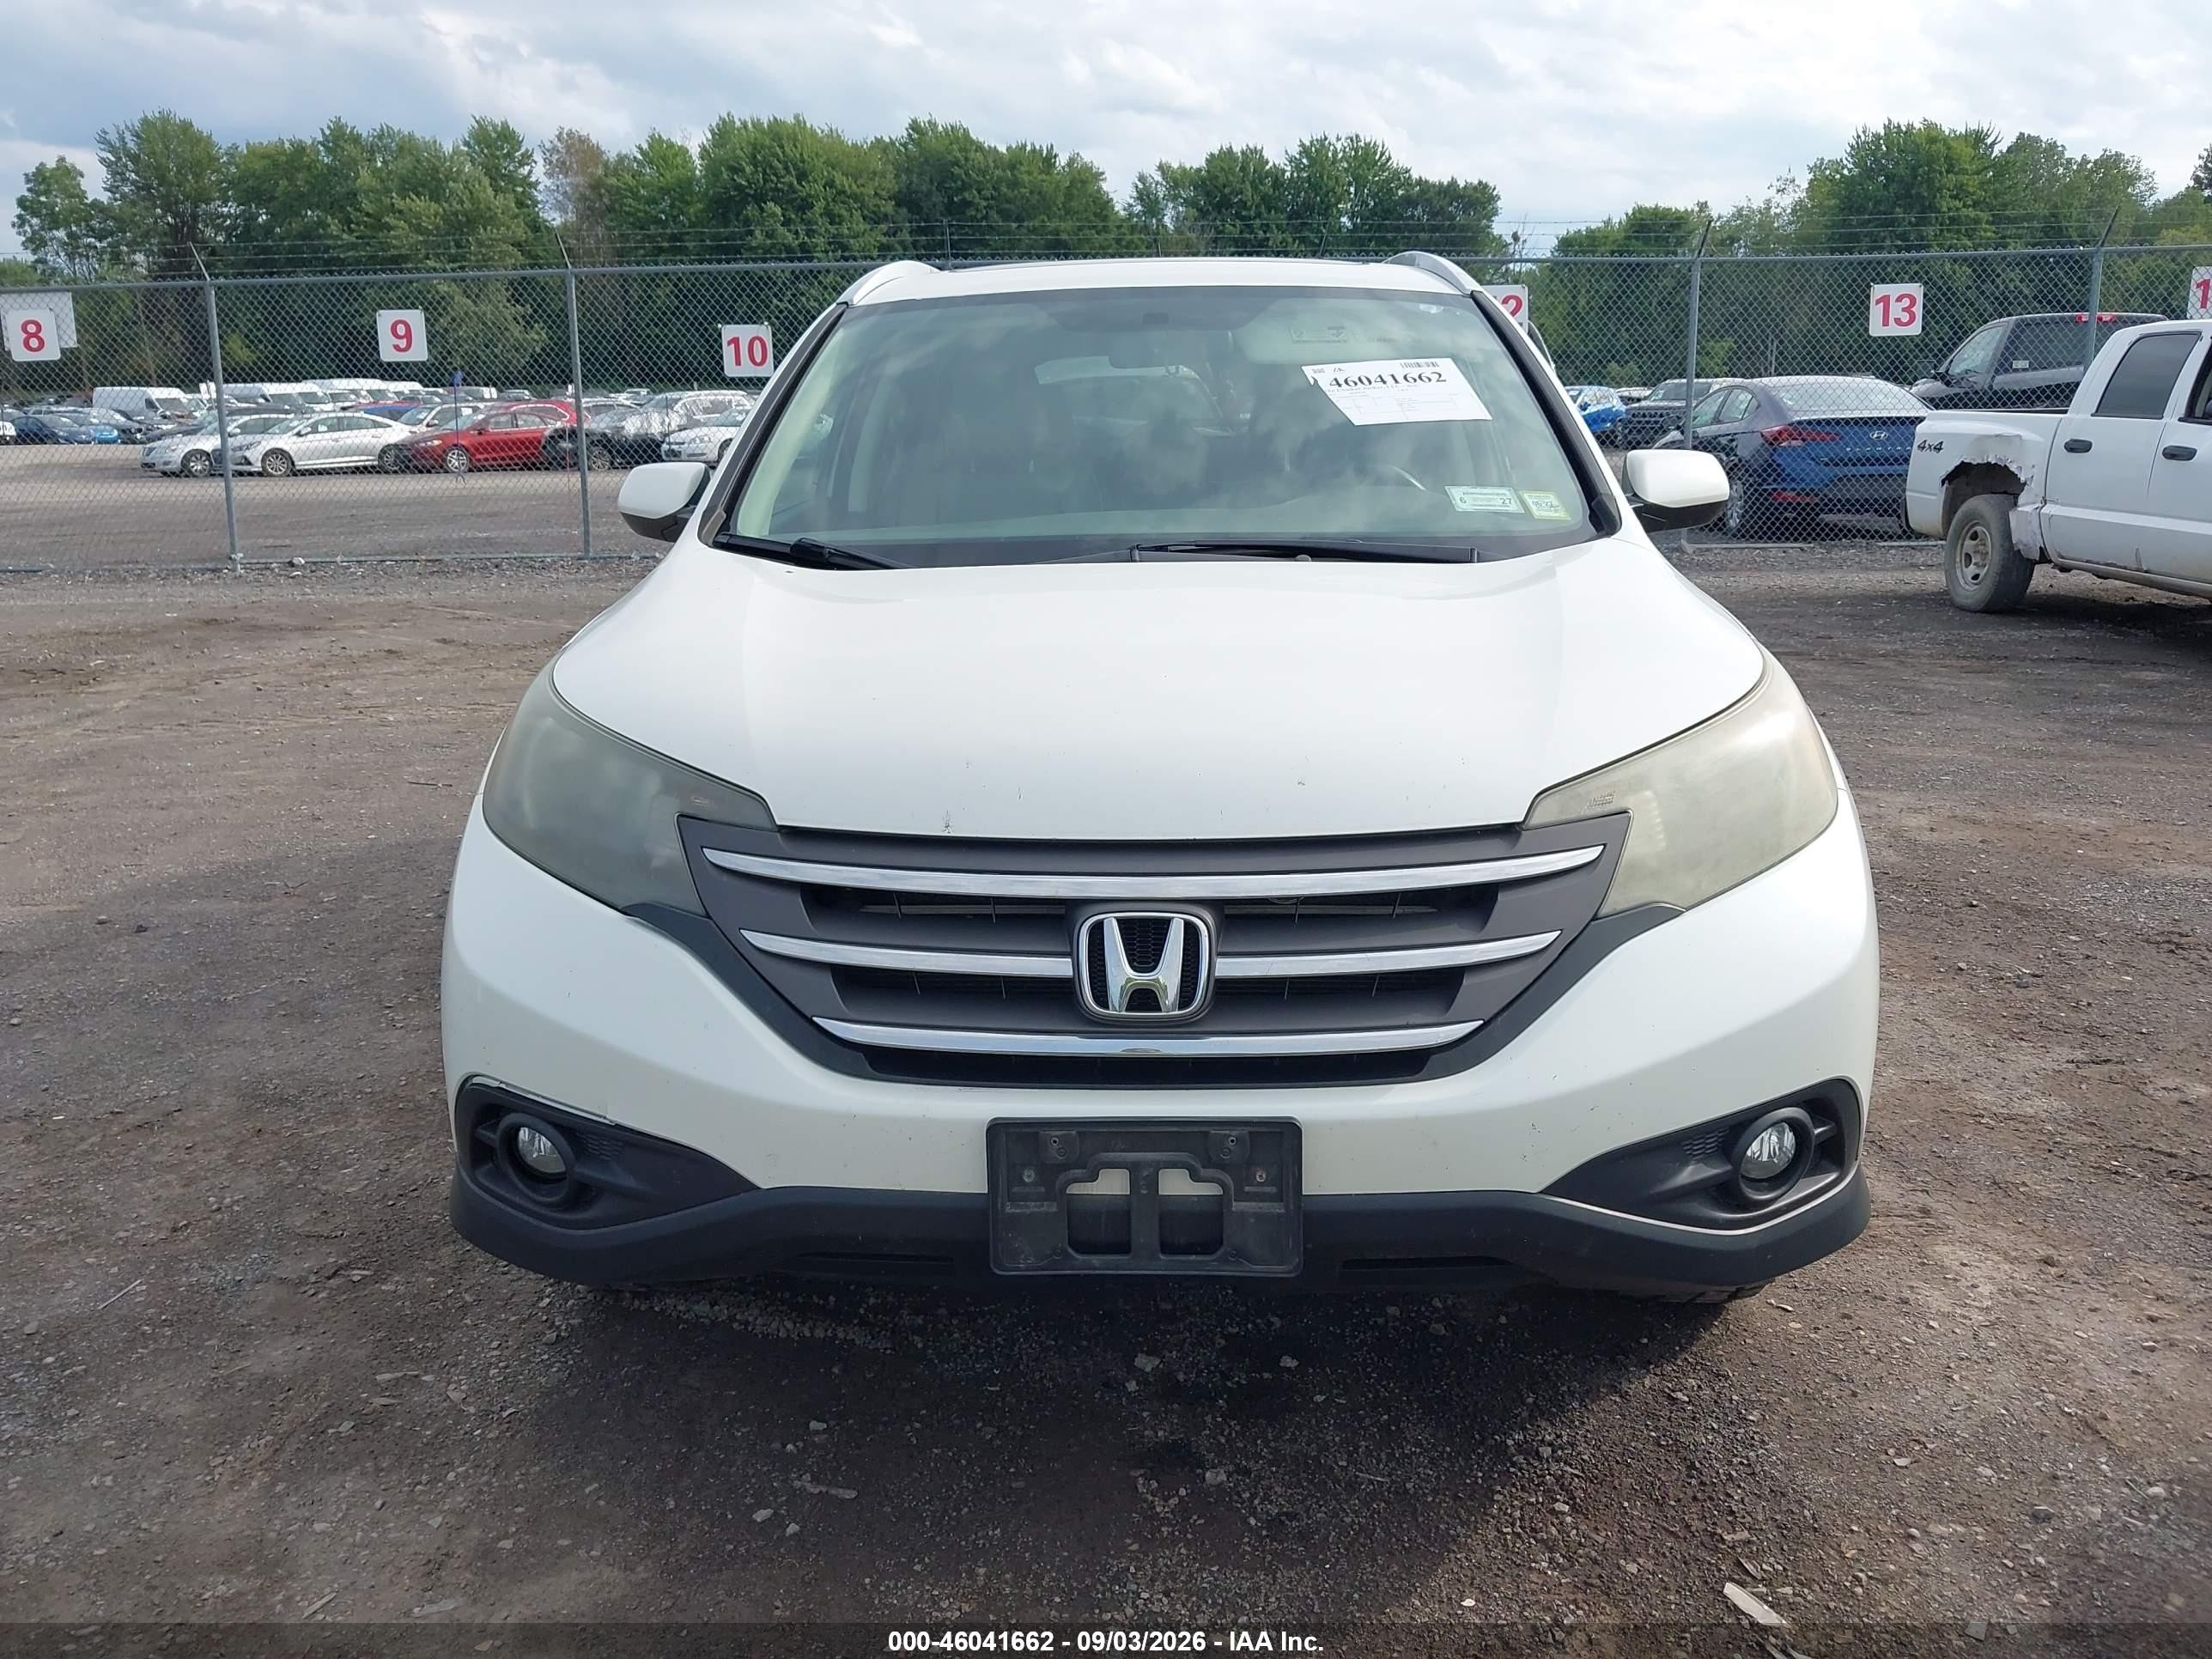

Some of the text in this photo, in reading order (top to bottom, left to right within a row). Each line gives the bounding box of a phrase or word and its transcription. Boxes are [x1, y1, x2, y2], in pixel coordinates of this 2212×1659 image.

[1875, 293, 1917, 327] 13
[2195, 278, 2212, 309] 1
[20, 319, 46, 353] 8
[390, 319, 413, 353] 9
[726, 335, 769, 368] 10
[1328, 371, 1447, 388] 46041662
[1916, 439, 1944, 454] 4x4
